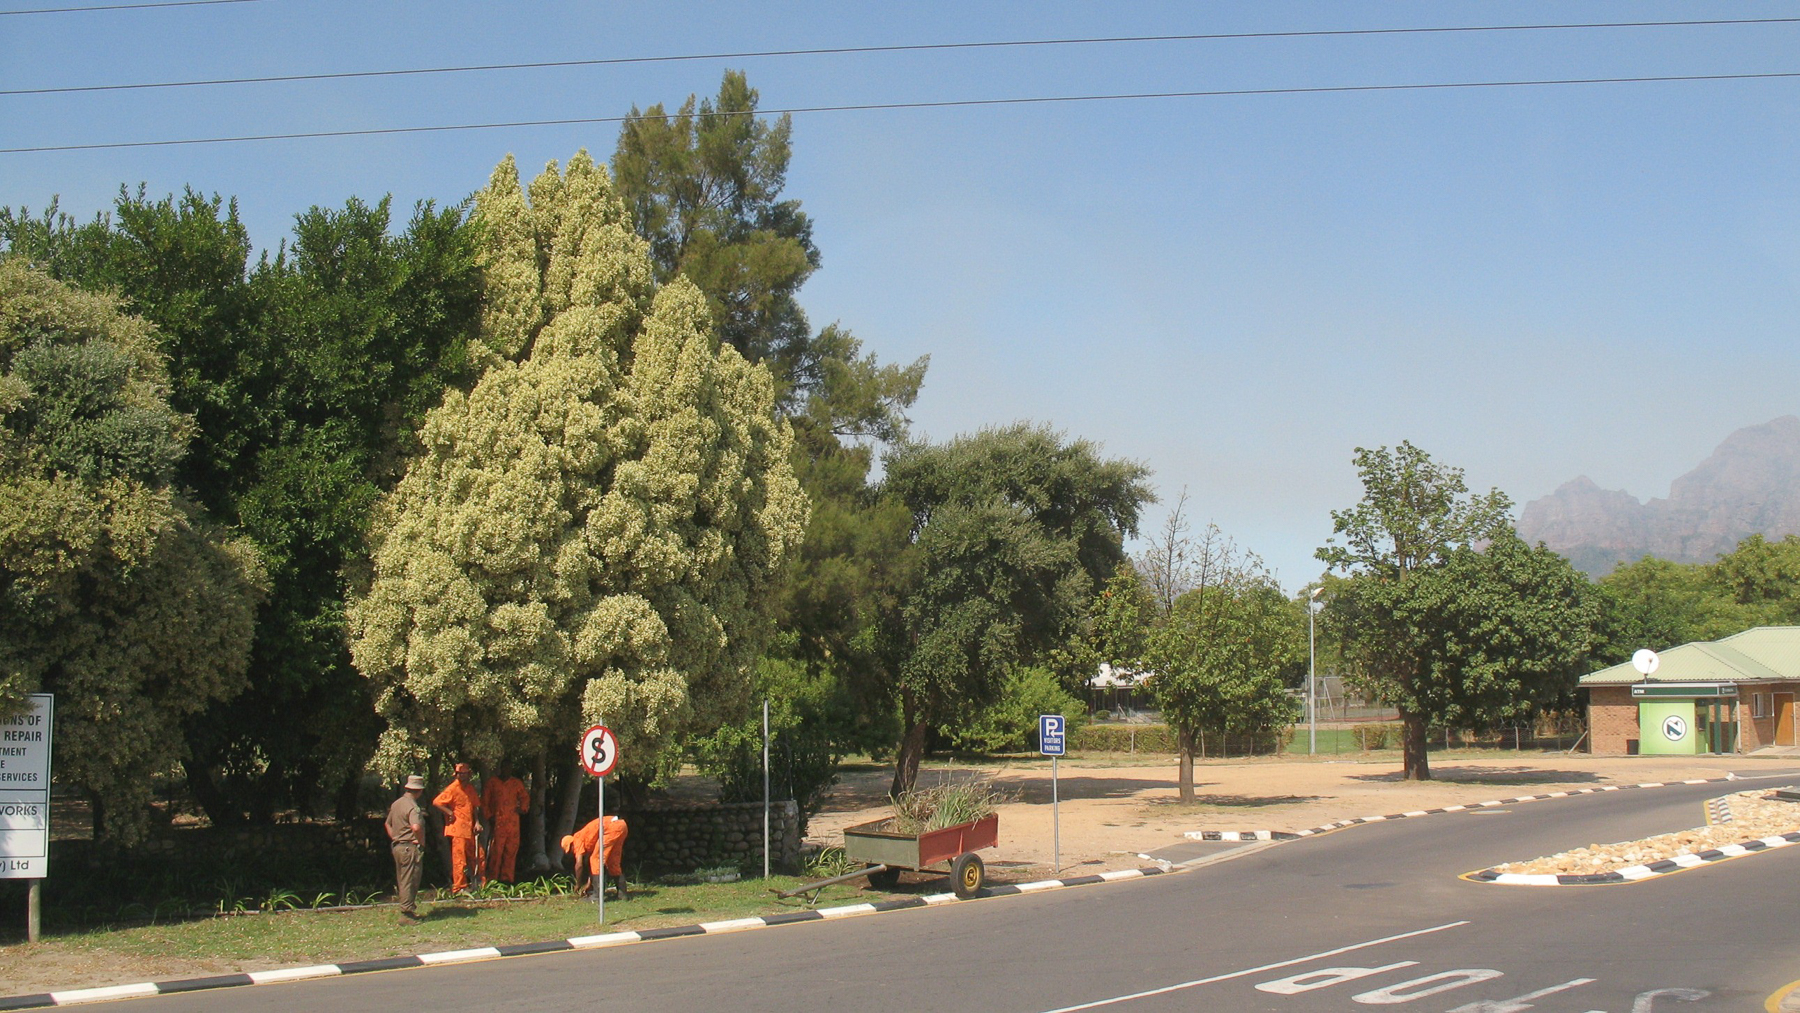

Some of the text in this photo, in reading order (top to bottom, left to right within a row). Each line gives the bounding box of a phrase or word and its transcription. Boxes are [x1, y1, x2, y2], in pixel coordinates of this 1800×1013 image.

[0, 715, 41, 726] ONS OF
[1045, 718, 1058, 736] P
[4, 731, 42, 741] REPAIR
[591, 737, 606, 763] S
[10, 860, 29, 870] Ltd
